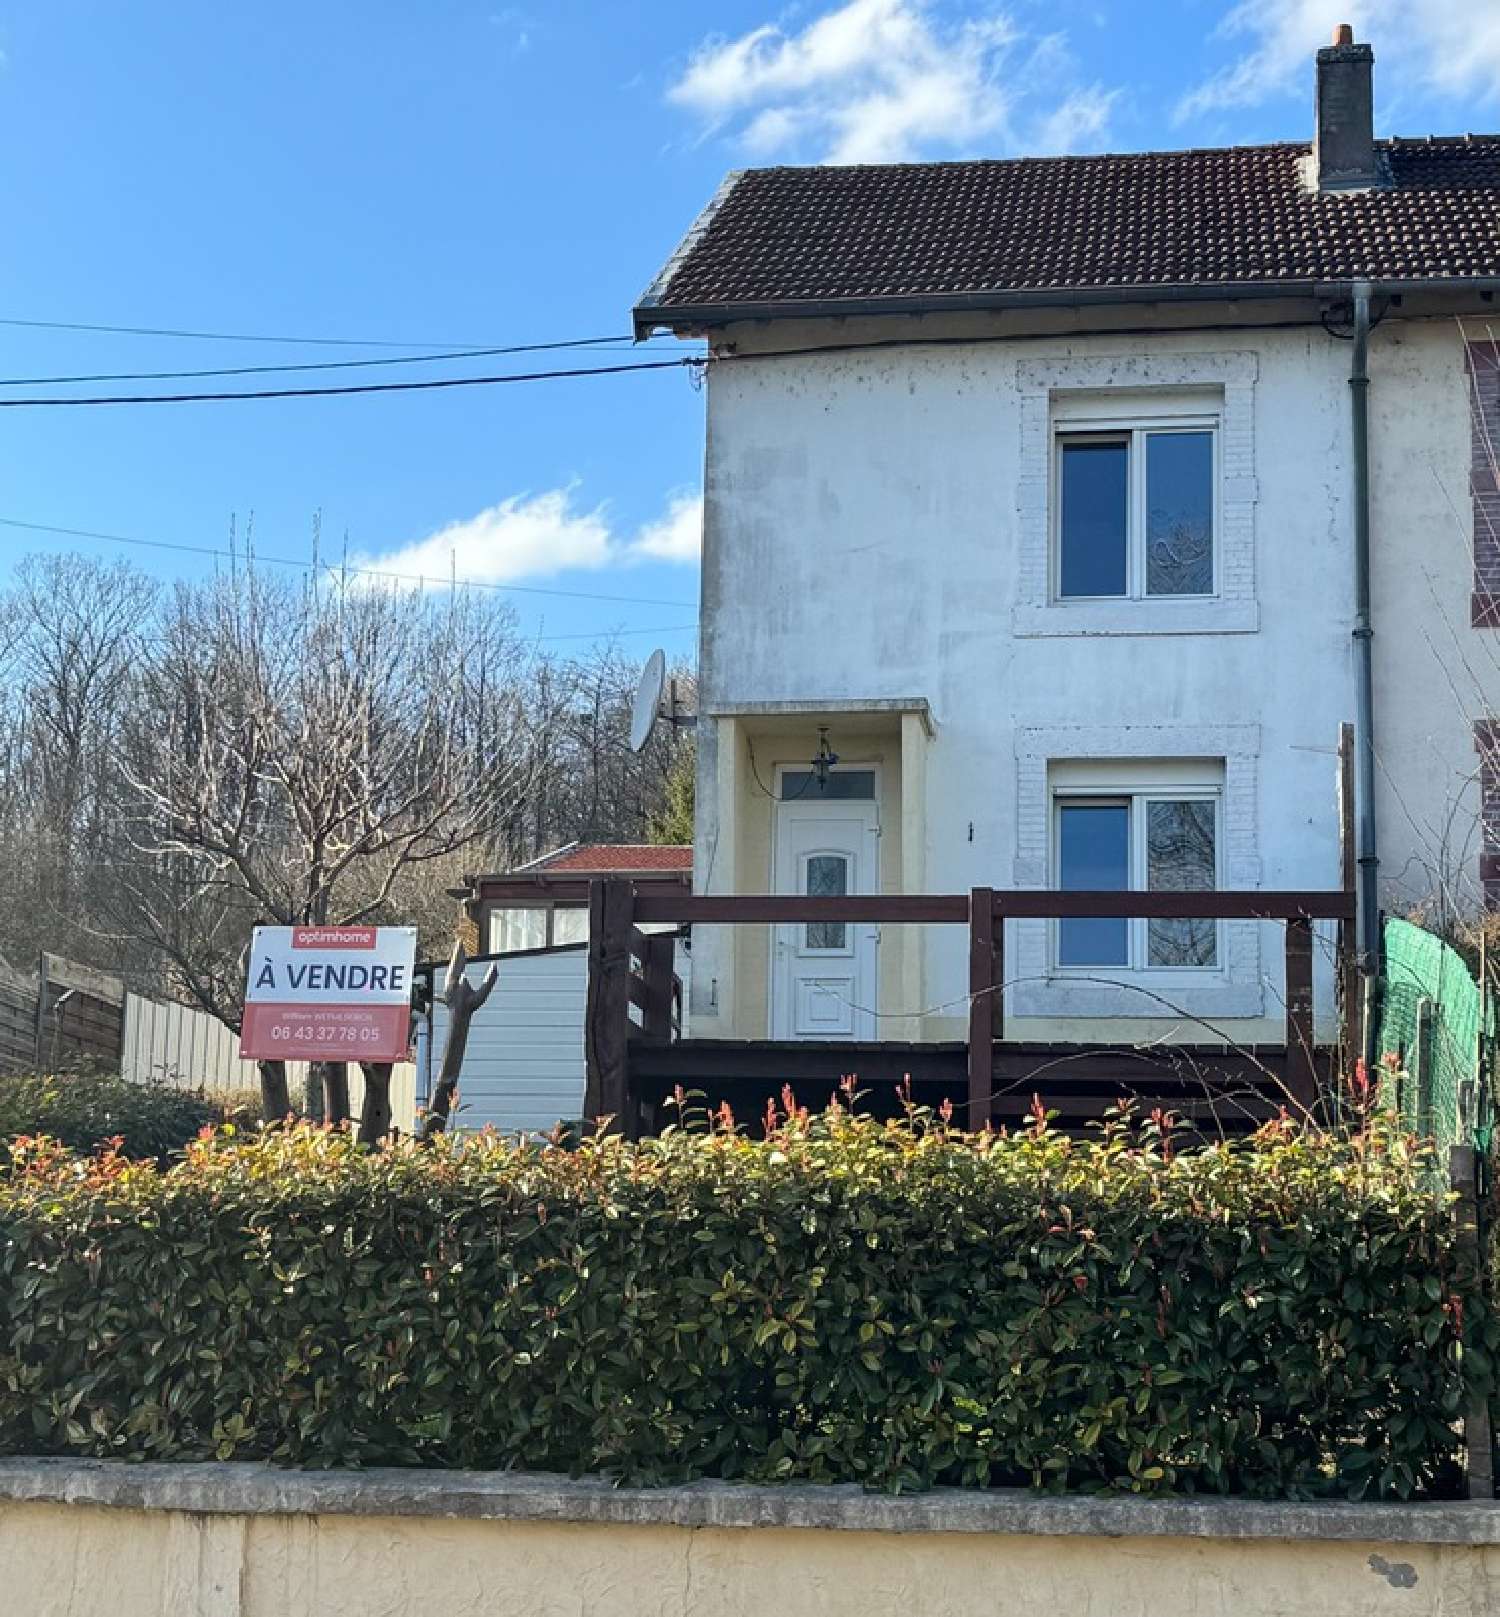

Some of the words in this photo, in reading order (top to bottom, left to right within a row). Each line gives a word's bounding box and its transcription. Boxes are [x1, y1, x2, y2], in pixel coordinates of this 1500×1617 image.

[299, 931, 370, 944] optimhome
[255, 956, 276, 989] À
[287, 963, 405, 990] VENDRE
[271, 1026, 289, 1040] 06
[294, 1026, 313, 1040] 43
[317, 1026, 336, 1041] 37
[338, 1027, 357, 1041] 78
[360, 1027, 380, 1041] 05
